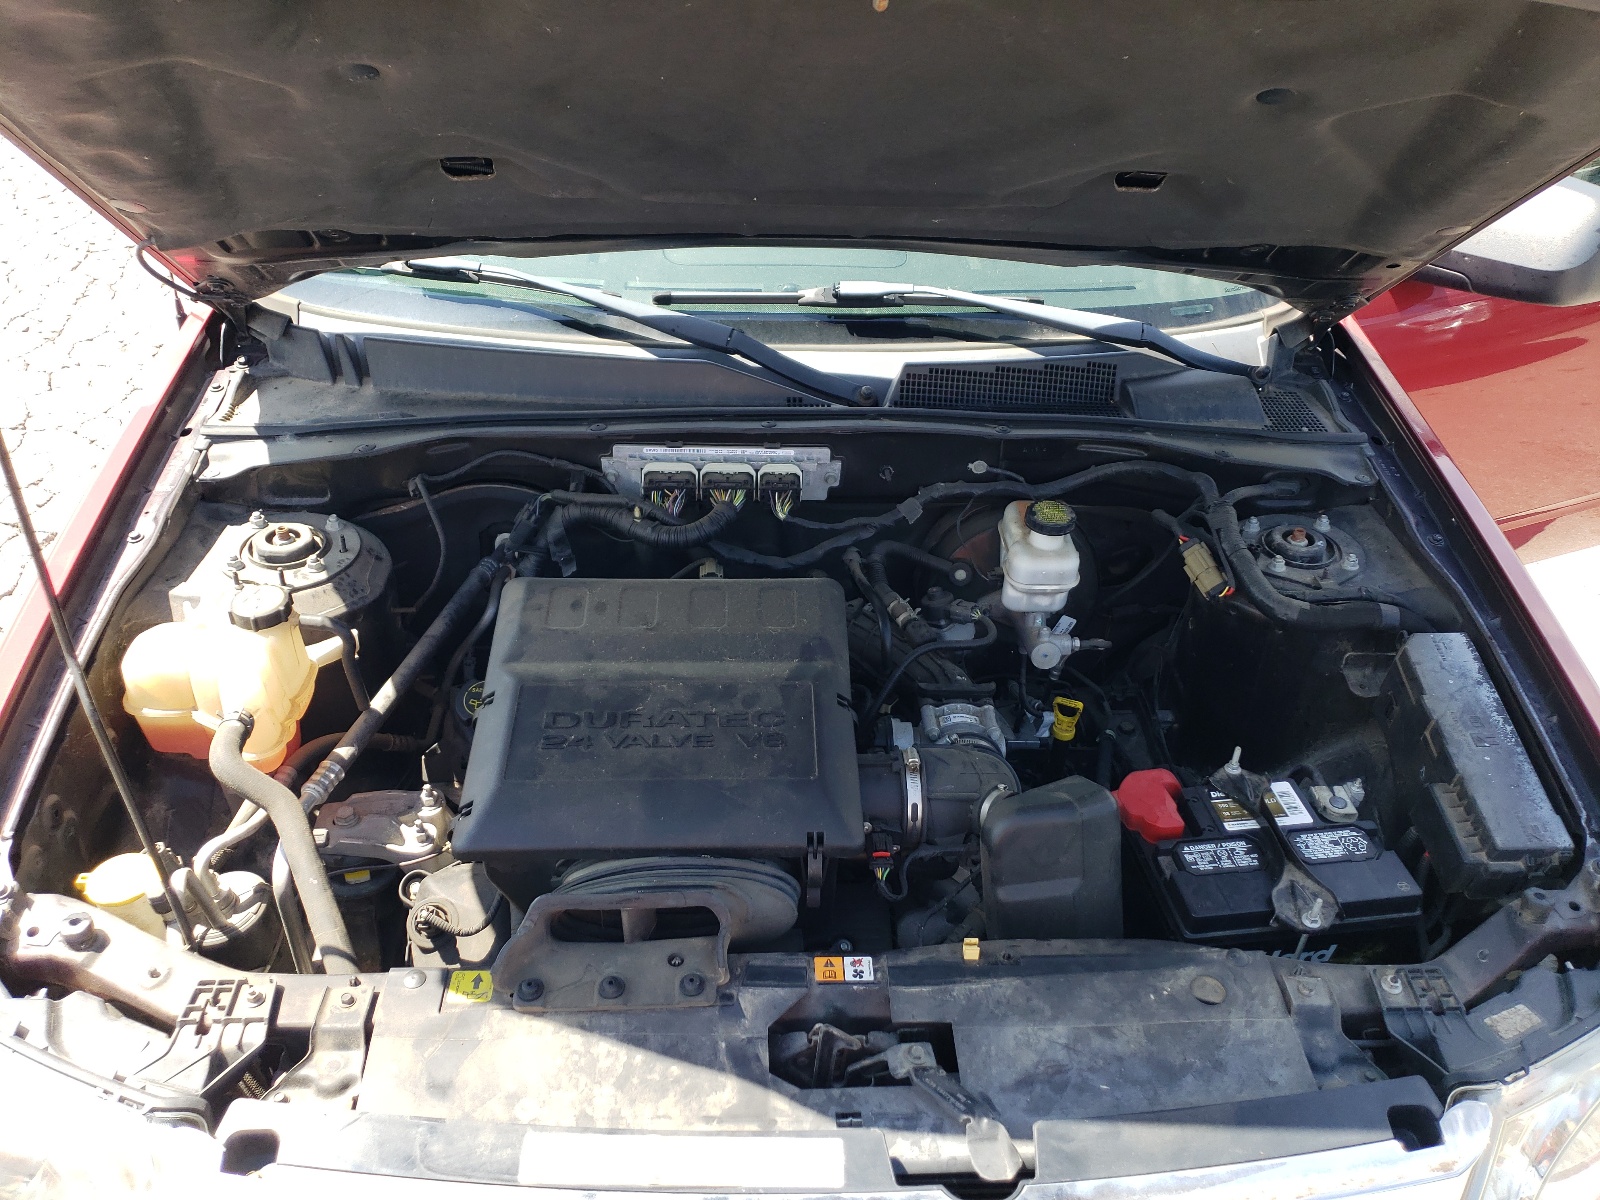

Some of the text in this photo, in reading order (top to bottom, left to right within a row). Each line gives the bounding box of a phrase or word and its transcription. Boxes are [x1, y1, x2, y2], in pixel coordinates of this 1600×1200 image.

[543, 710, 786, 730] DURATEC
[541, 731, 788, 750] 24 VALVE V6
